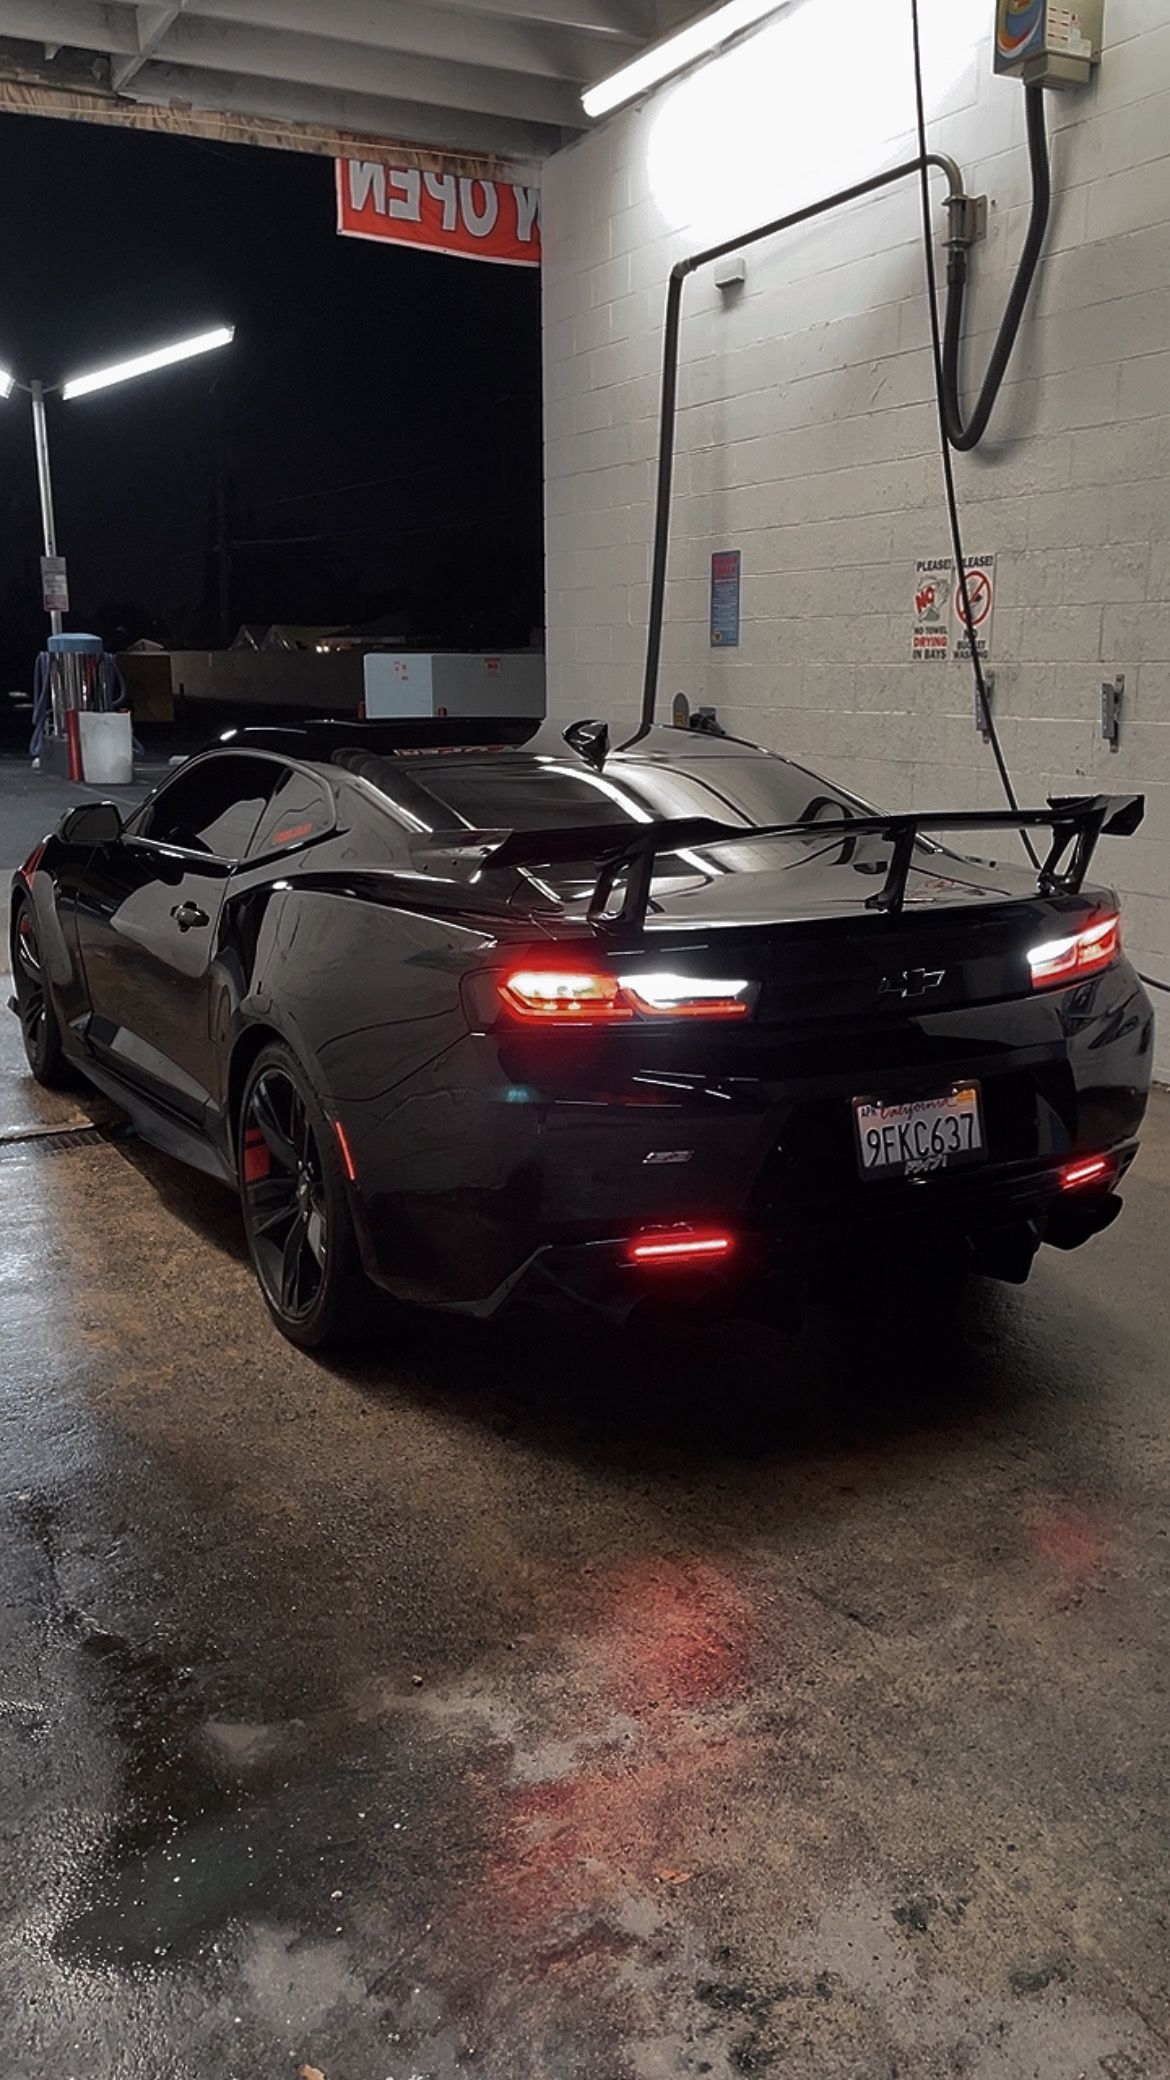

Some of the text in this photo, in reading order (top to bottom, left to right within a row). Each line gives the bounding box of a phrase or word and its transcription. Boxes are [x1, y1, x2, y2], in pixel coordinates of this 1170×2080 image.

[961, 556, 993, 568] LEASE!
[915, 586, 935, 614] NO
[914, 626, 948, 635] NO TOWEL
[913, 636, 947, 648] DRYING
[957, 640, 986, 650] BUCET
[913, 649, 947, 660] IN BAYS
[953, 650, 988, 659] WASNG
[866, 1112, 974, 1166] 9FKC637
